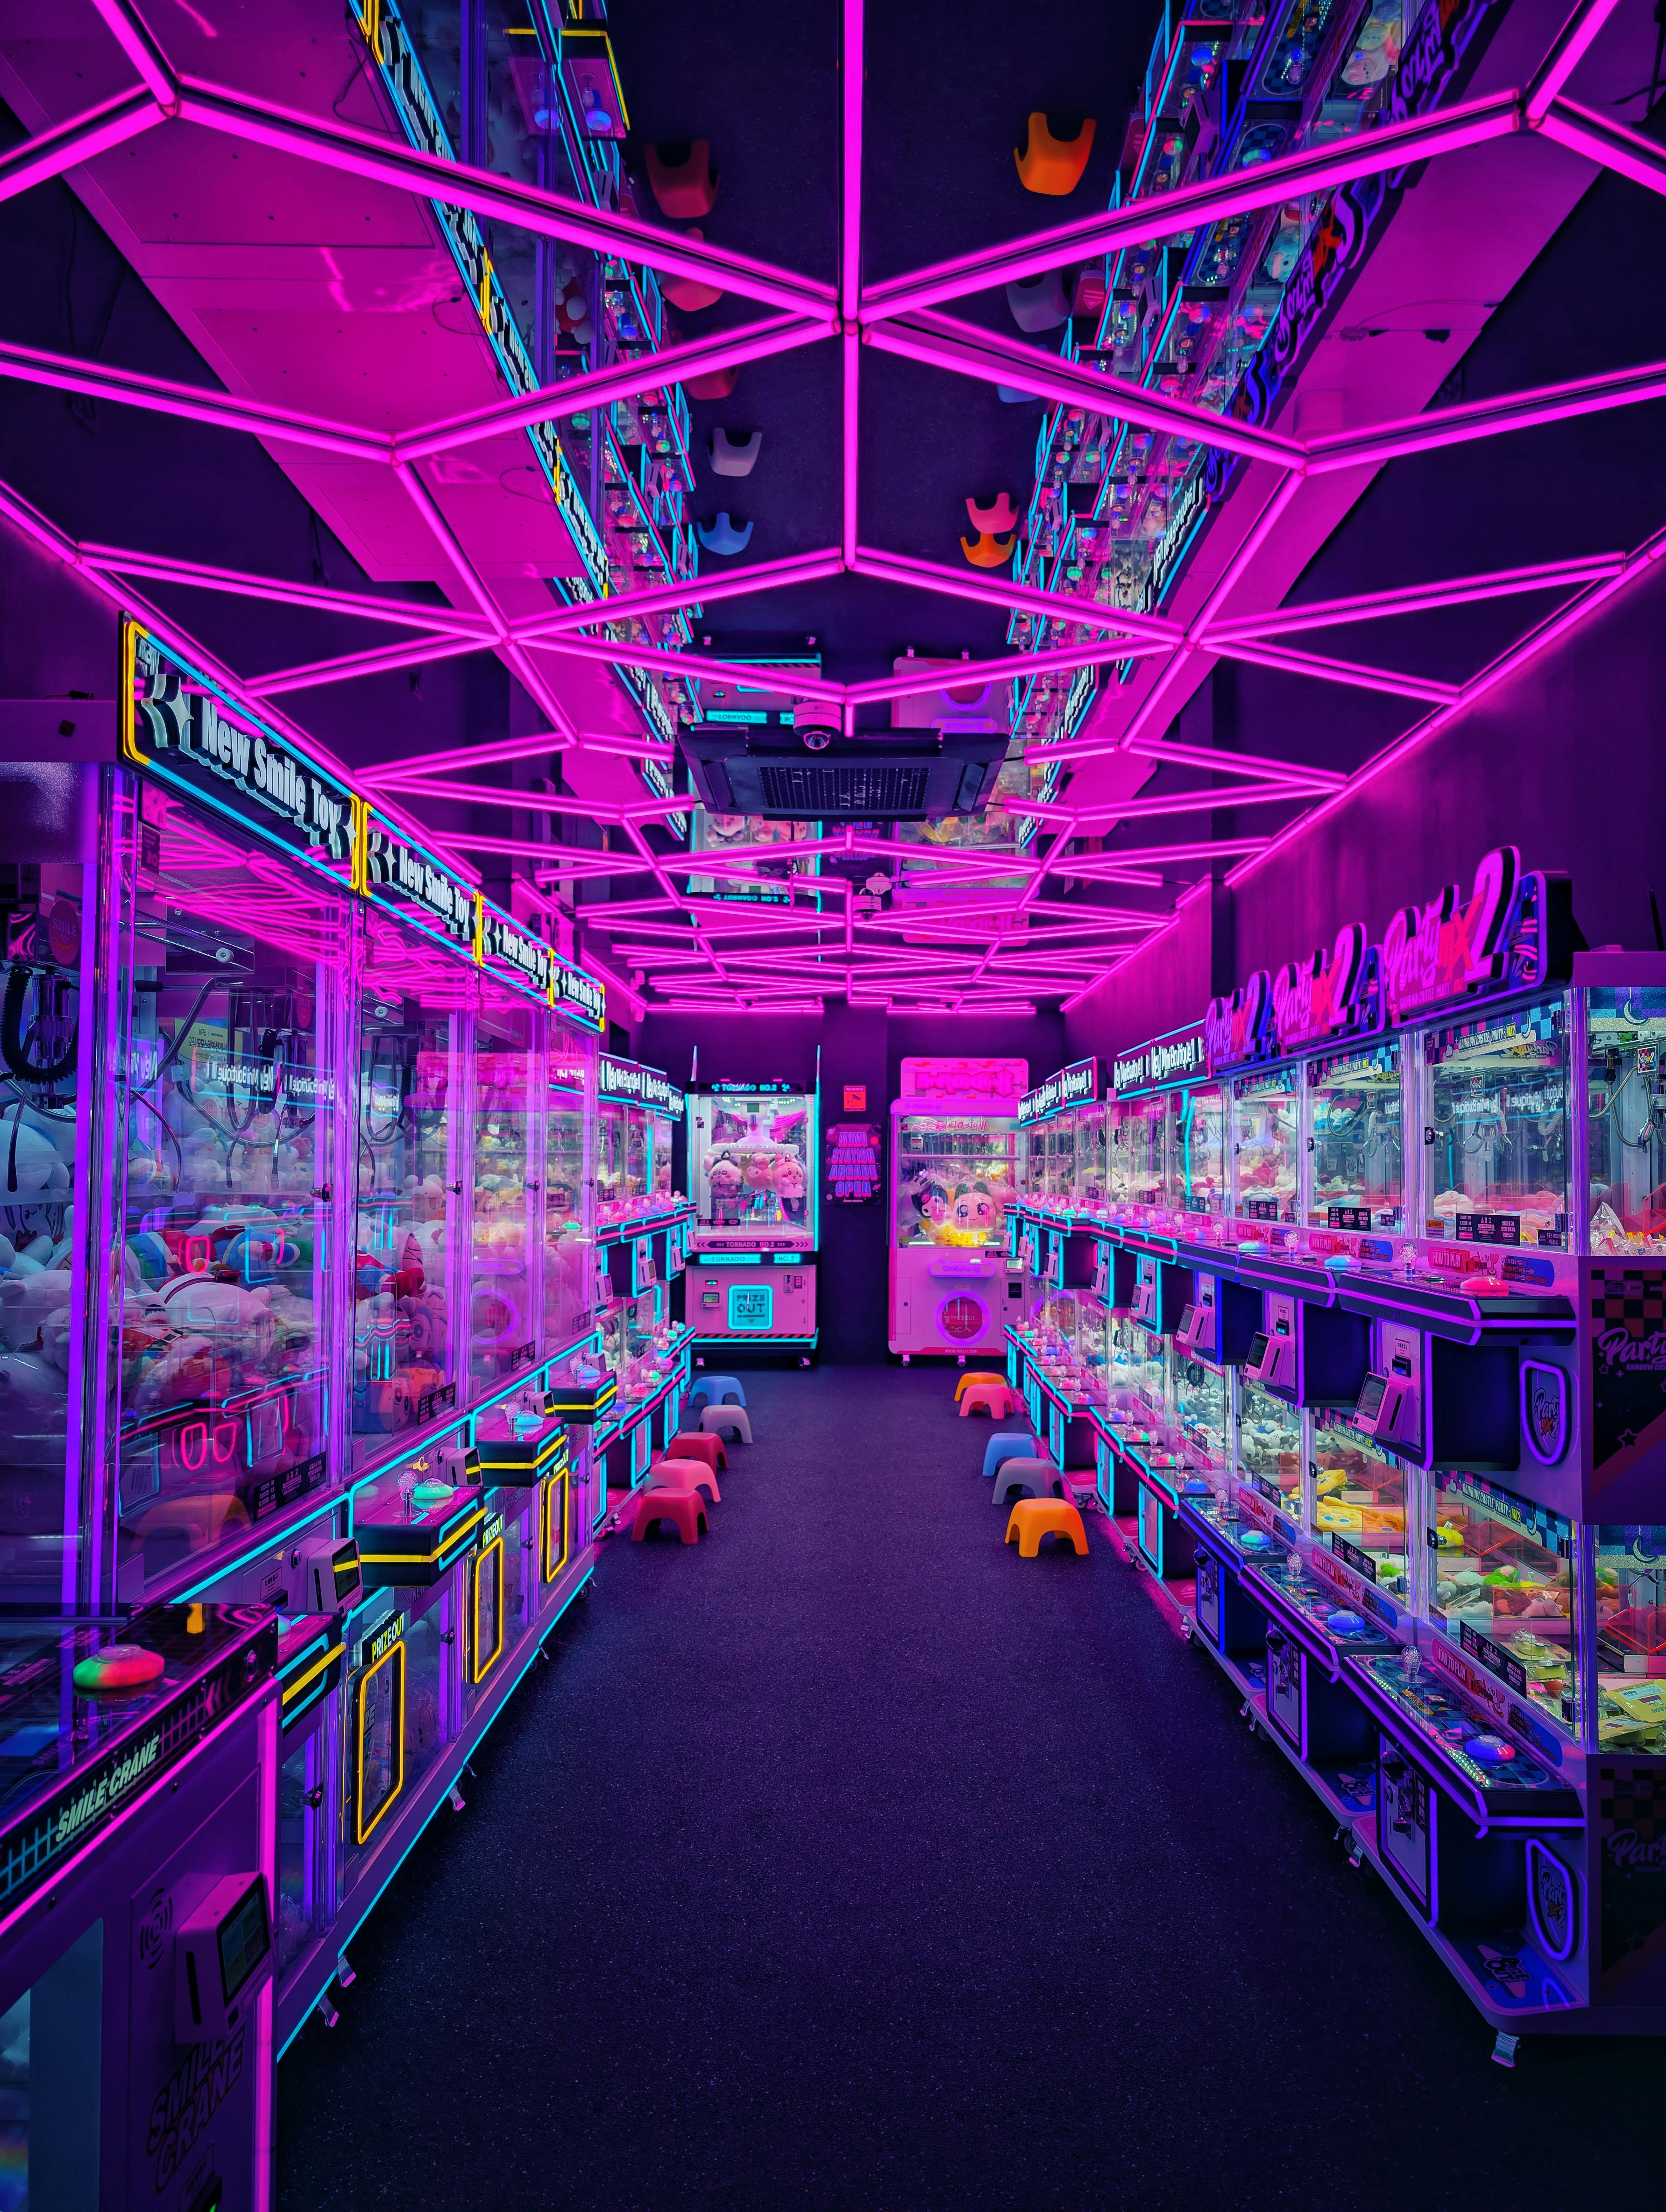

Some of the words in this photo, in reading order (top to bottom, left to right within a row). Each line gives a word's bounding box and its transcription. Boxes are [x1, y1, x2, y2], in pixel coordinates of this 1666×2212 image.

[202, 696, 250, 777] New
[254, 738, 306, 814] Smile
[311, 778, 339, 845] Toy
[400, 845, 424, 894] New
[425, 864, 453, 915] Smile
[455, 887, 470, 928] Toy
[52, 917, 77, 937] SMILE
[503, 924, 518, 959] New
[518, 935, 537, 971] Smile
[537, 948, 548, 980] Toy
[1384, 885, 1446, 1001] Party
[568, 972, 579, 1000] New
[579, 979, 593, 1009] Smile
[1400, 991, 1419, 1009] RAINBOW
[1419, 986, 1434, 1005] CASTLE
[1459, 1034, 1476, 1049] RAINBOW
[1476, 1032, 1490, 1046] CASTLE
[1330, 1065, 1343, 1077] RAINBOW
[1342, 1063, 1351, 1075] CASTLE
[838, 1132, 868, 1147] MOMO
[831, 1148, 876, 1164] STATION
[828, 1165, 878, 1181] ARCADE
[835, 1181, 872, 1197] OPEN
[1320, 1238, 1324, 1249] TO
[1324, 1239, 1332, 1251] PLAY
[1433, 1251, 1444, 1265] HOW
[1444, 1252, 1450, 1266] TO
[1450, 1253, 1462, 1268] PLAY
[737, 1303, 765, 1313] OUT
[1333, 1422, 1345, 1436] RAINBOW
[1345, 1428, 1355, 1441] CASTLE
[1462, 1483, 1481, 1501] RAINBOW
[1480, 1492, 1494, 1508] CASTLE
[1322, 1558, 1328, 1573] TO
[1327, 1562, 1335, 1577] PLAY
[1436, 1645, 1447, 1664] HOW
[1447, 1654, 1454, 1671] TO
[1454, 1659, 1466, 1681] PLAY
[56, 1779, 106, 1843] SMILE
[109, 1734, 161, 1797] CRANE
[155, 2019, 245, 2195] CRANE
